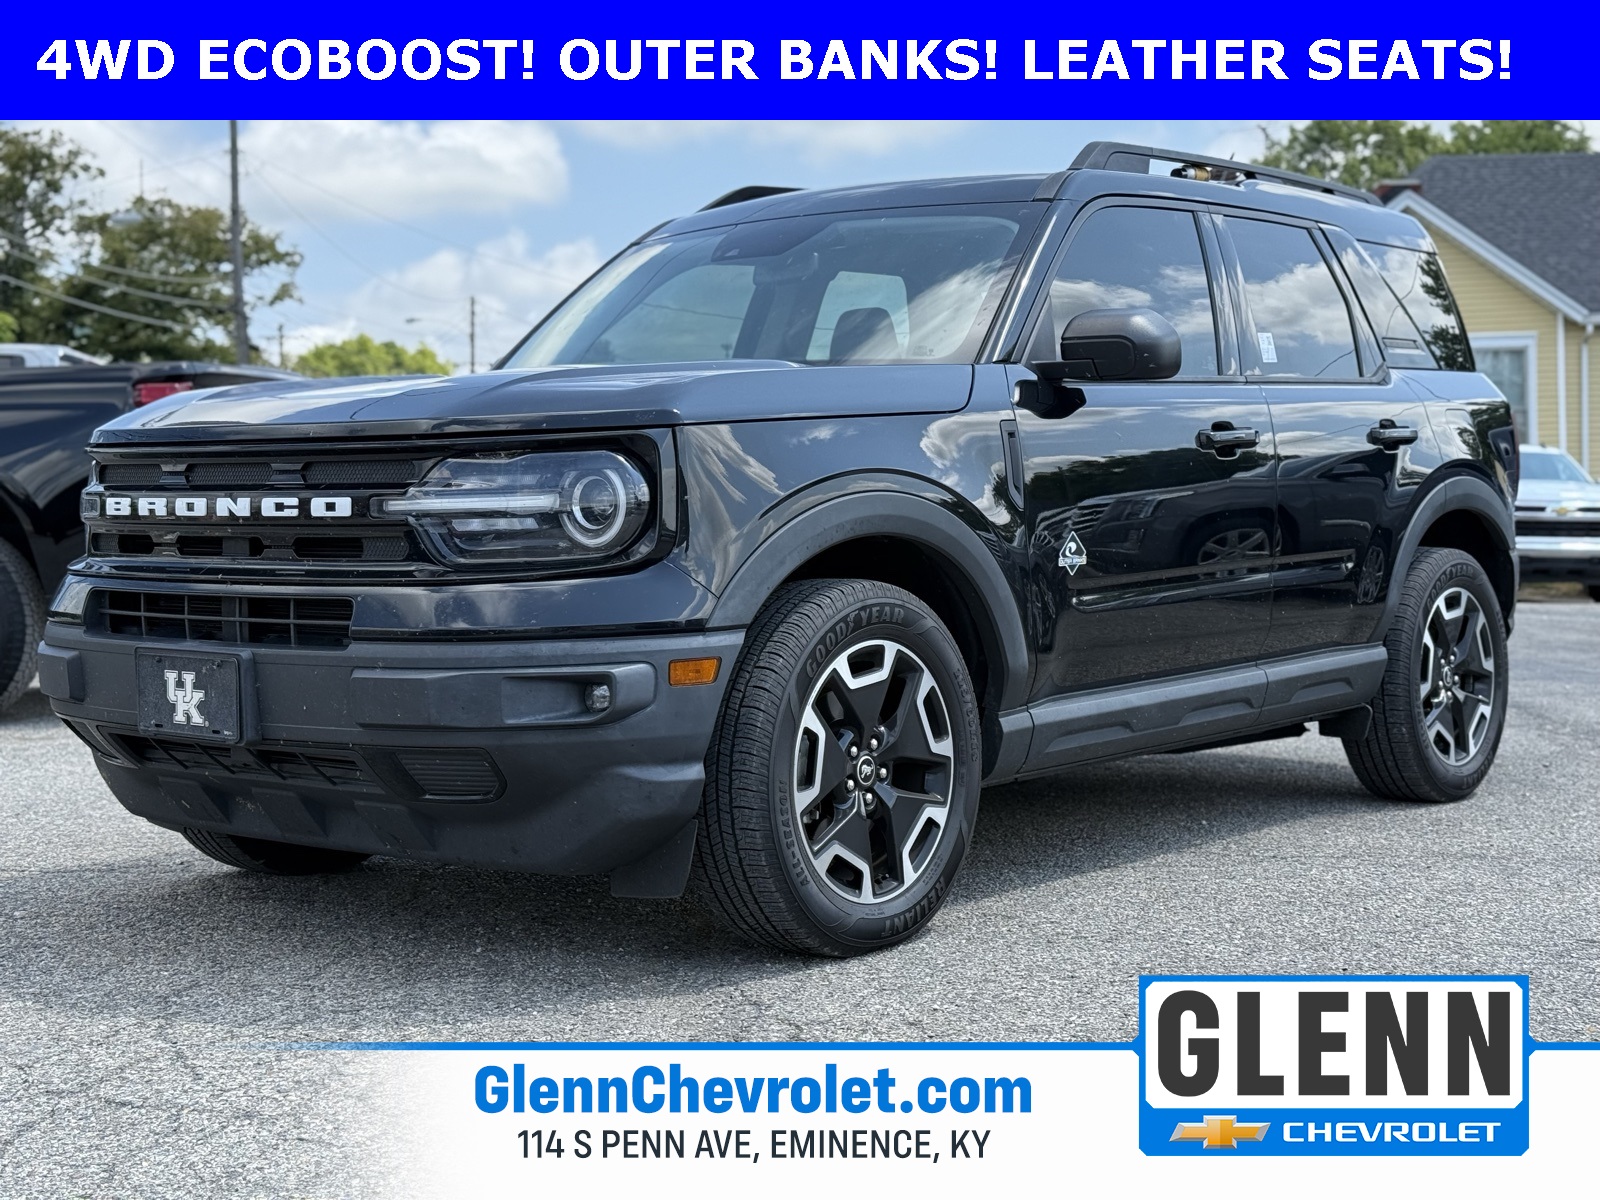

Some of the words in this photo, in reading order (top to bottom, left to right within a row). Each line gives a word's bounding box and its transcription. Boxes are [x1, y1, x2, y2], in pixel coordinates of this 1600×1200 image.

[105, 496, 352, 517] BRONCO
[806, 606, 905, 678] GOODYEAR
[881, 876, 946, 937] RELIANT
